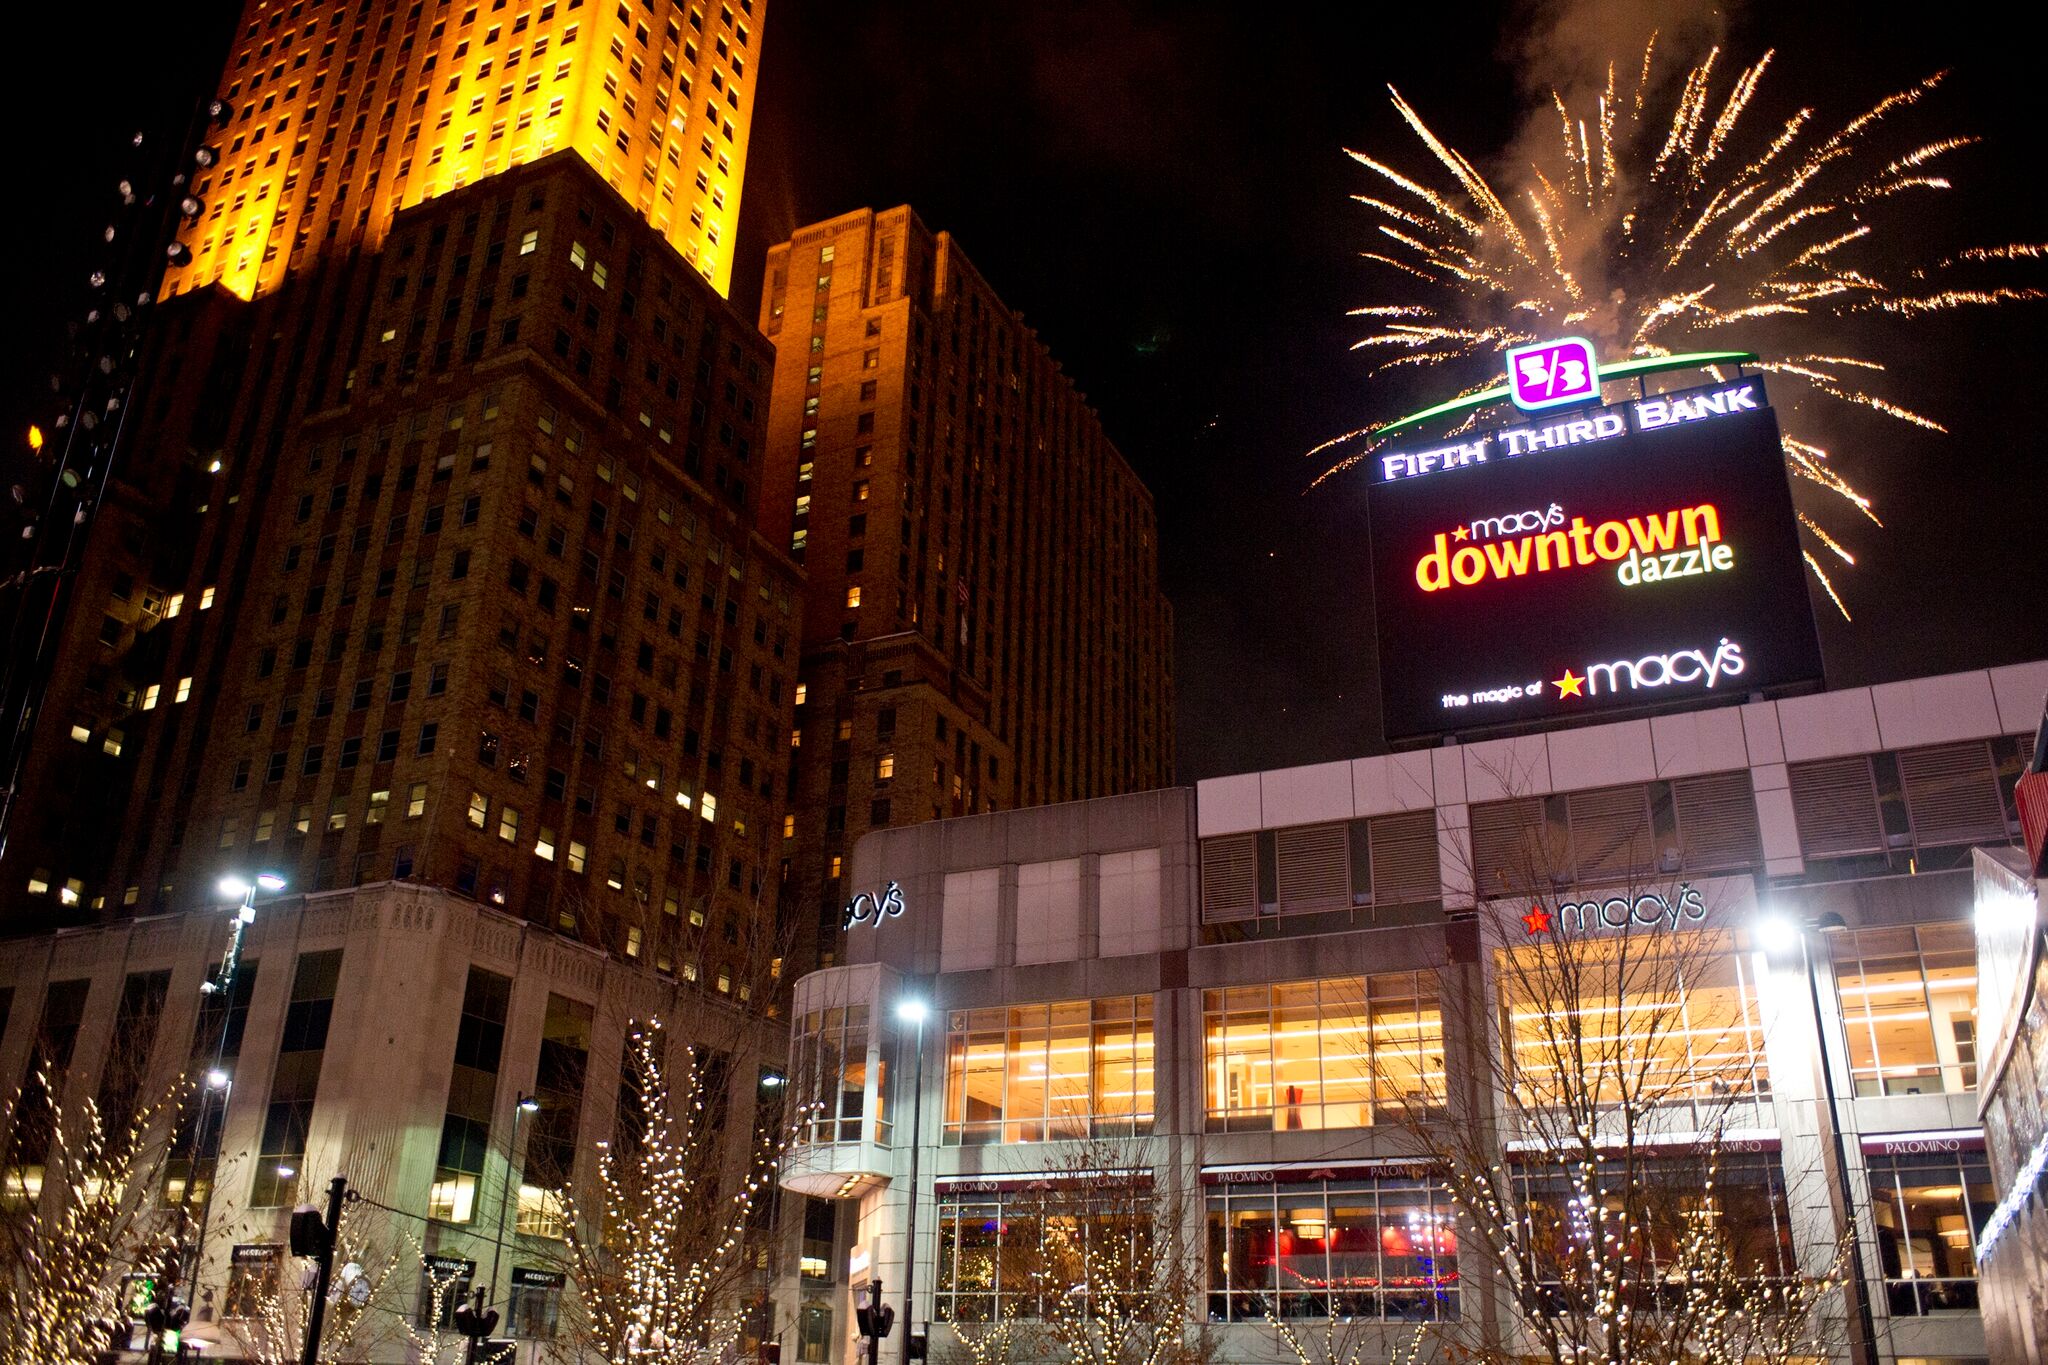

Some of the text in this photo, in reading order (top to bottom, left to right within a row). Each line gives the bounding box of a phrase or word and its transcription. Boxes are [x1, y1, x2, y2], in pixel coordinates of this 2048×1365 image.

[1381, 385, 1758, 481] FIFTH THIRD BANK
[1471, 502, 1565, 541] macy's
[1415, 504, 1721, 592] downtown
[1617, 536, 1734, 587] dazzle
[1442, 637, 1745, 708] the magic of macy's
[1559, 882, 1707, 934] macy's
[1885, 1139, 1960, 1154] PALOMINO
[949, 1181, 999, 1193] PALOMINO
[1218, 1170, 1274, 1183] PALOMINO
